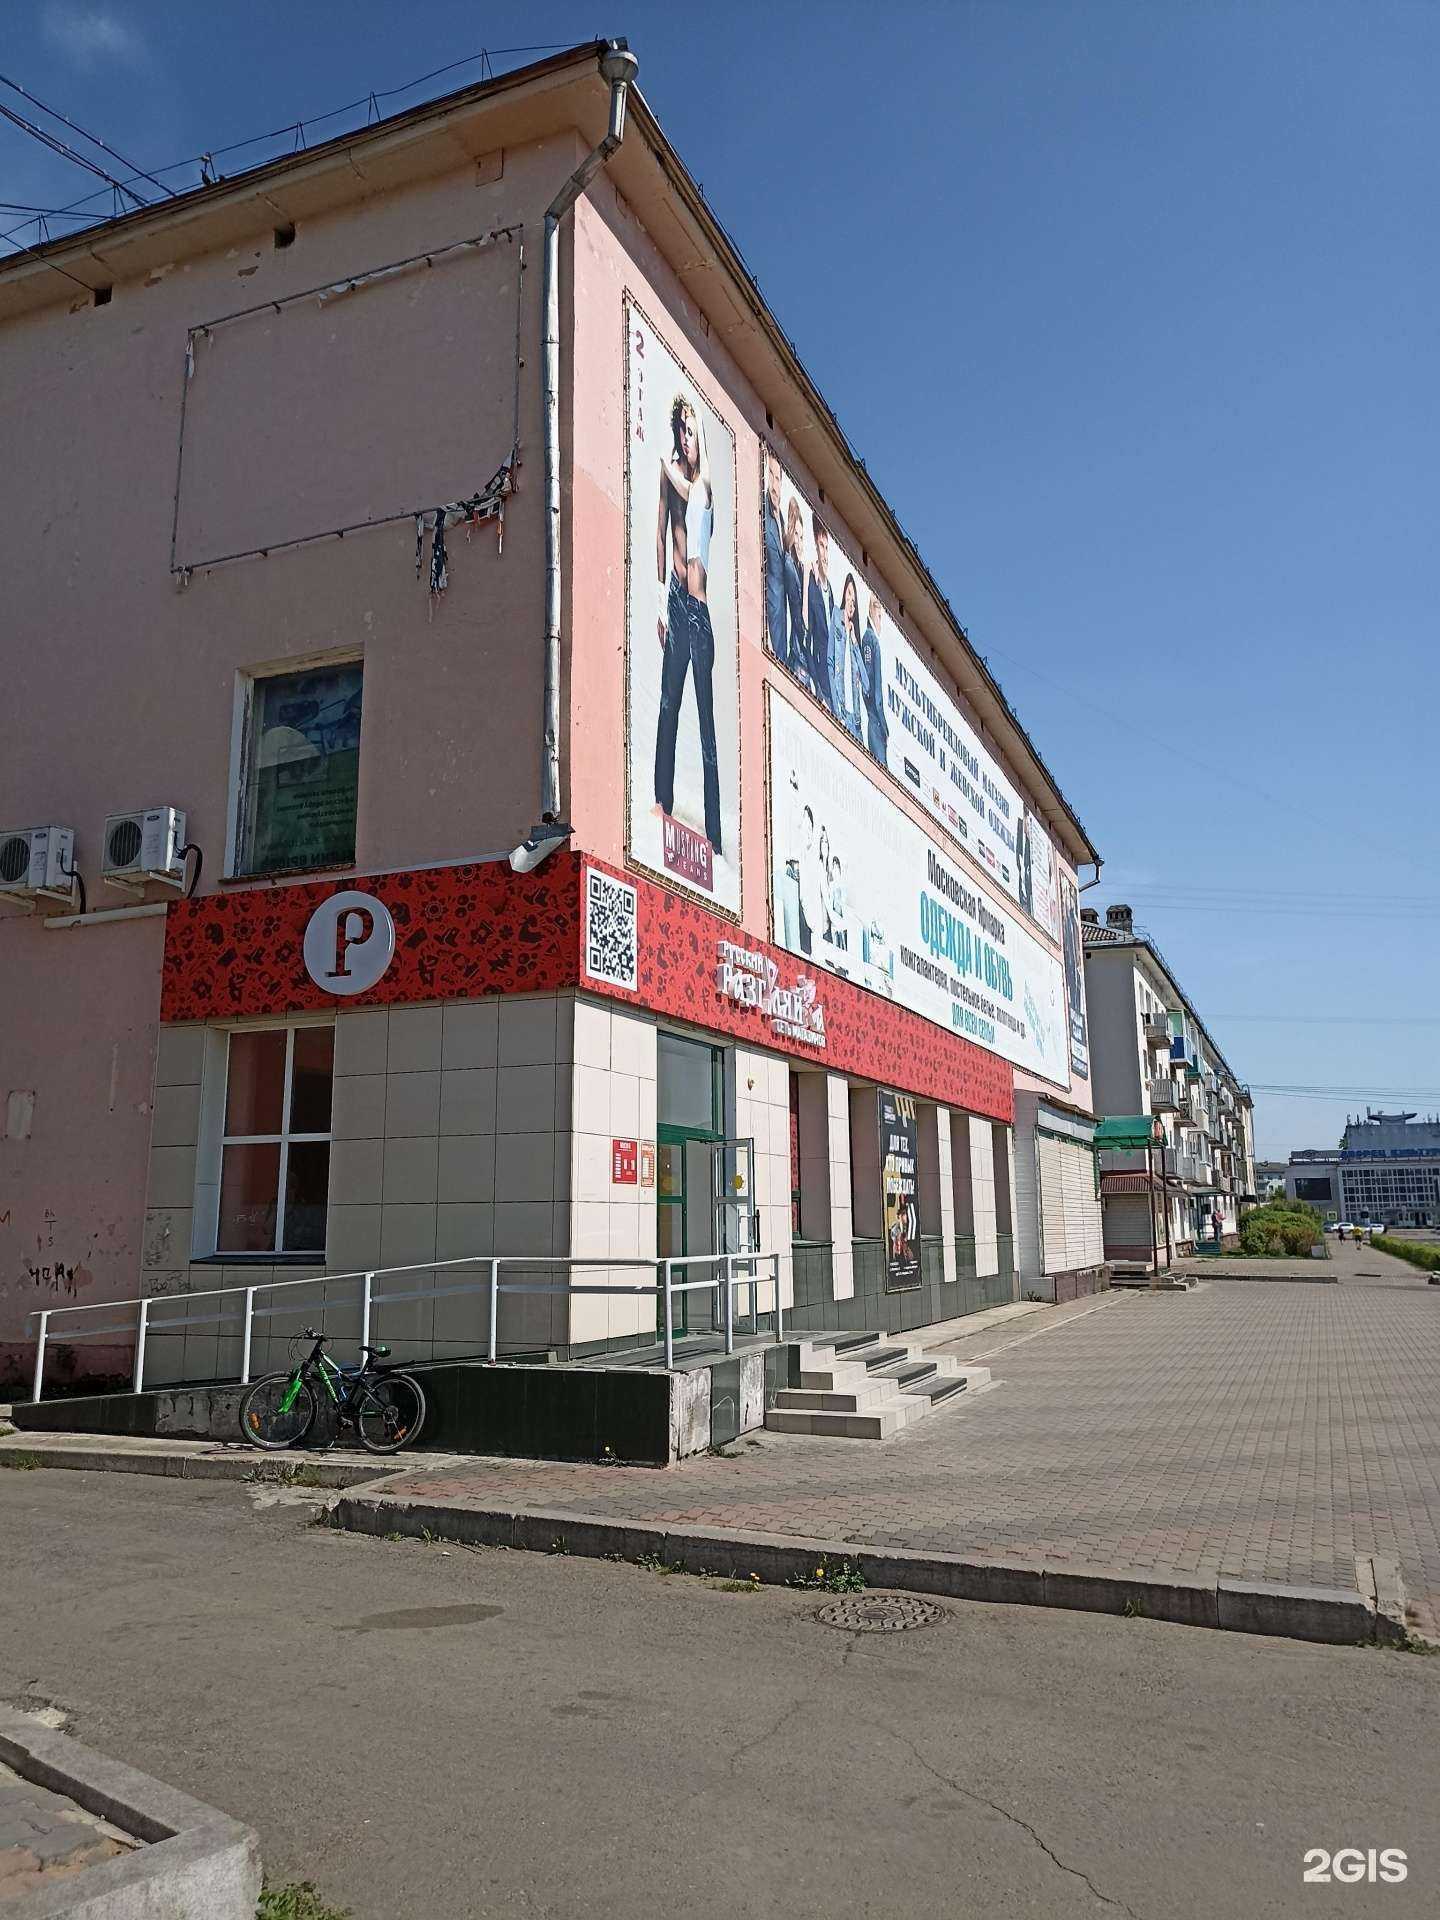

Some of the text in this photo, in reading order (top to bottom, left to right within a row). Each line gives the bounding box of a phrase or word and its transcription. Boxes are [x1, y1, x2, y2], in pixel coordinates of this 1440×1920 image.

[635, 330, 645, 359] 2
[887, 683, 936, 759] МУЖСКОЙ
[939, 748, 946, 772] И
[950, 760, 985, 819] ЖЕНСКОЙ
[895, 656, 1010, 819] МУЛЬТИБРЕНДОВЫЙ МАГАЗИН
[665, 821, 708, 868] MUSTANG
[676, 859, 708, 880] JEANS
[927, 849, 976, 921] Московская
[920, 890, 1013, 1002] ОДЕЖДА И ОБУВЬ
